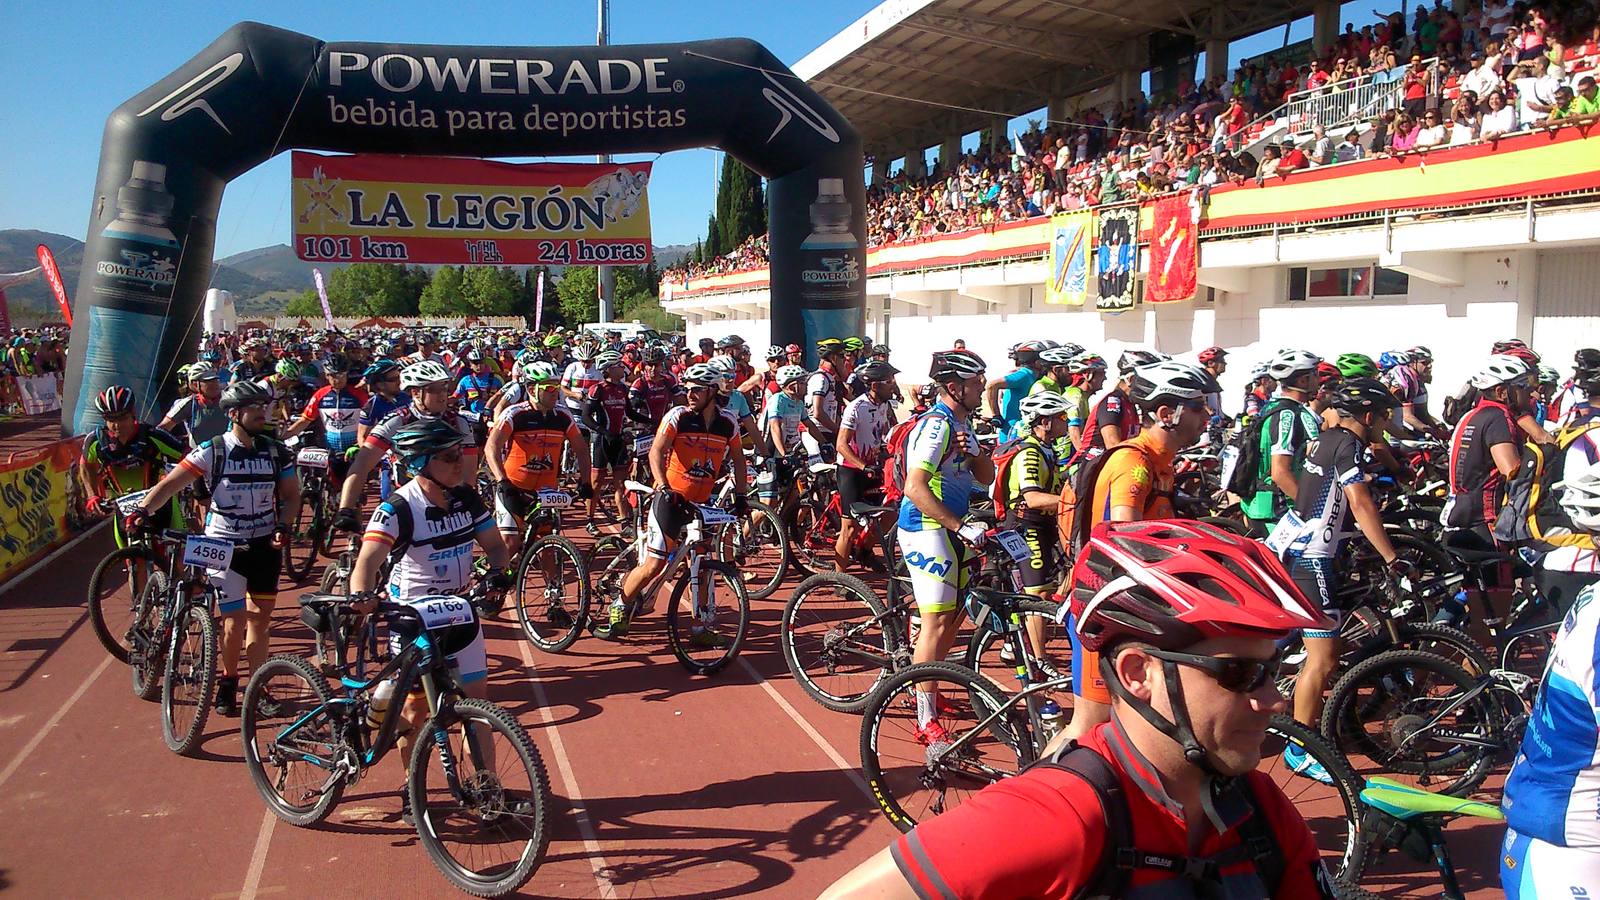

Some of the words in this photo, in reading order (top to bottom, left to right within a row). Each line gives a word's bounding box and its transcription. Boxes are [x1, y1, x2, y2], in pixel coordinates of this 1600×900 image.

[329, 52, 672, 95] POWERADE
[329, 96, 438, 128] bebida
[447, 109, 516, 136] para
[524, 105, 687, 136] deportistas
[345, 189, 414, 229] LA
[426, 187, 606, 231] LEGIÓN
[303, 238, 352, 259] 101
[362, 238, 408, 259] km
[538, 242, 571, 263] 24
[577, 240, 647, 261] horas
[96, 261, 176, 283] POWERADE
[546, 496, 567, 504] 5060
[1323, 481, 1344, 544] ORBEA
[193, 545, 226, 561] 4586
[1312, 558, 1330, 606] ORBEA
[870, 779, 900, 822] MAXXIS
